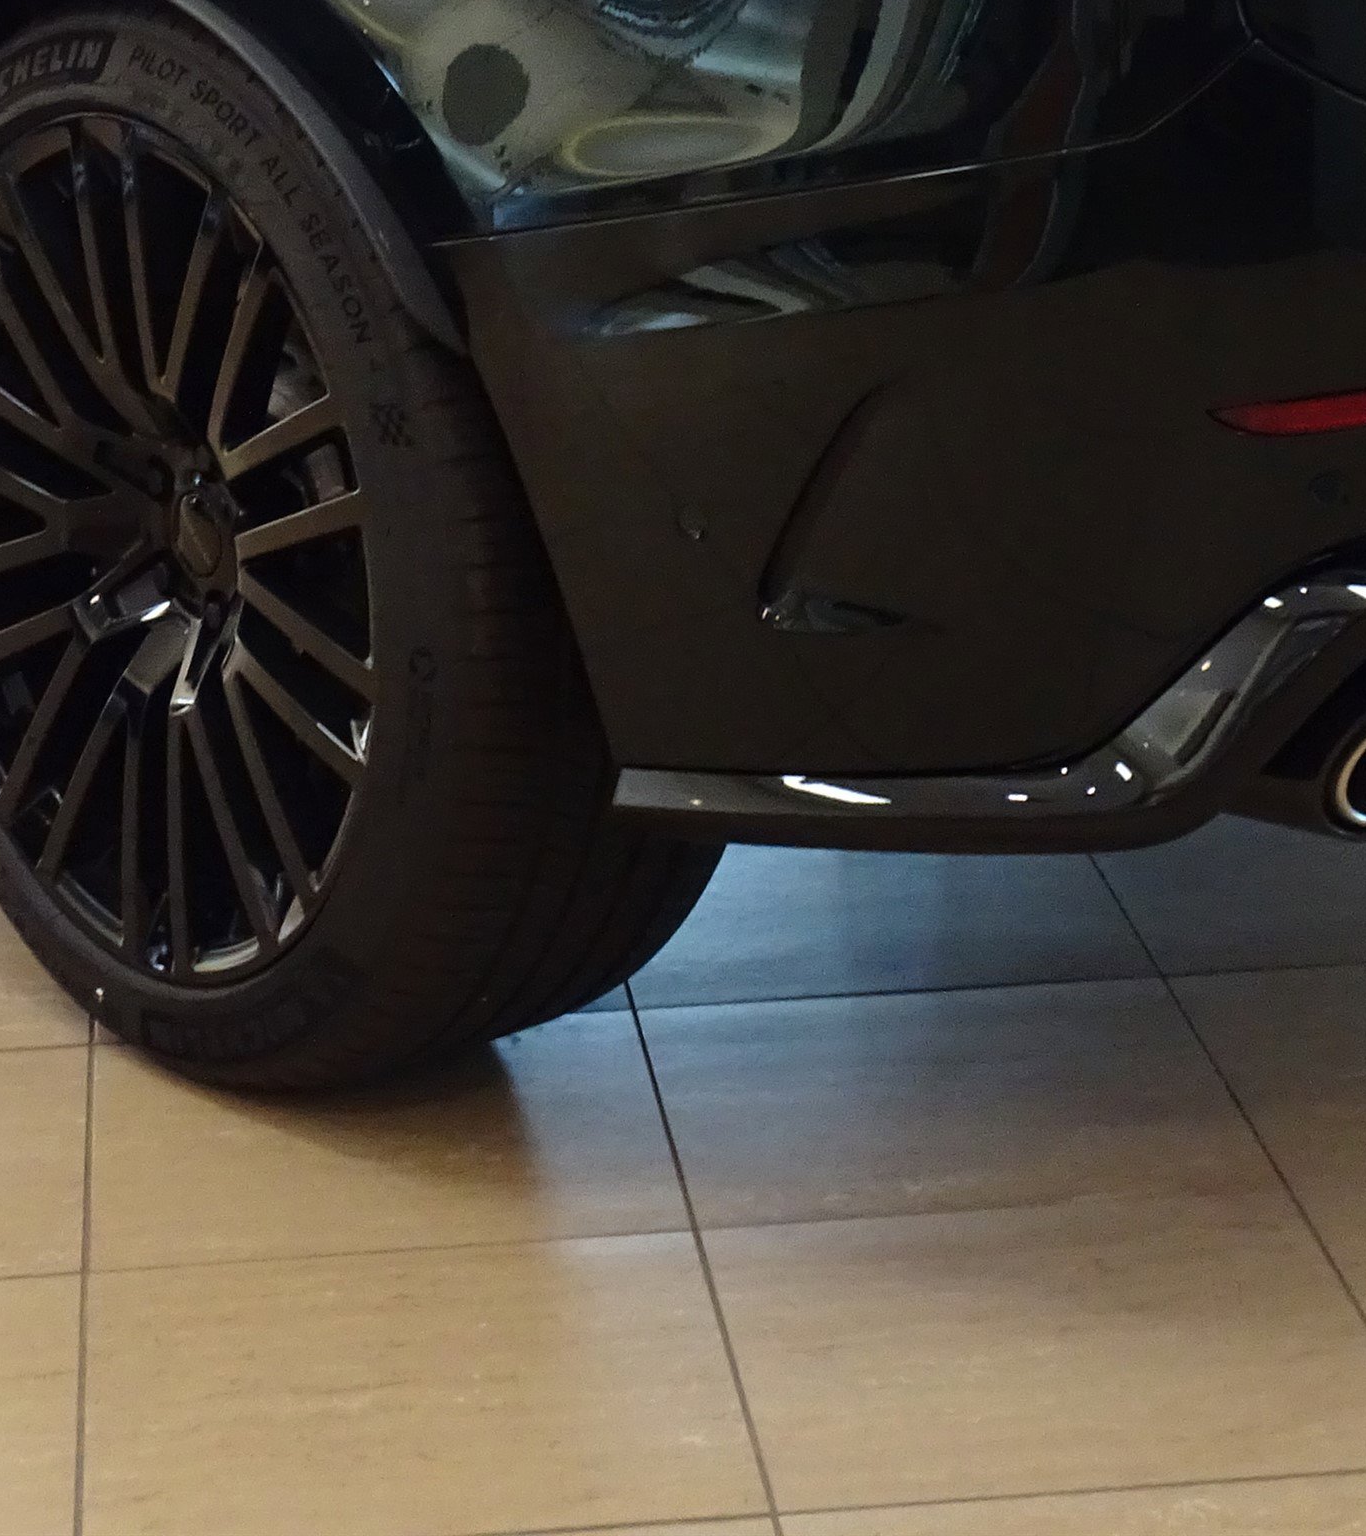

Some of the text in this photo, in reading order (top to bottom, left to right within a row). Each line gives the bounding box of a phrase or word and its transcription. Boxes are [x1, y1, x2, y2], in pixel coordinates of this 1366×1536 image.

[128, 45, 373, 345] PILOT SPORT ALL SEASON
